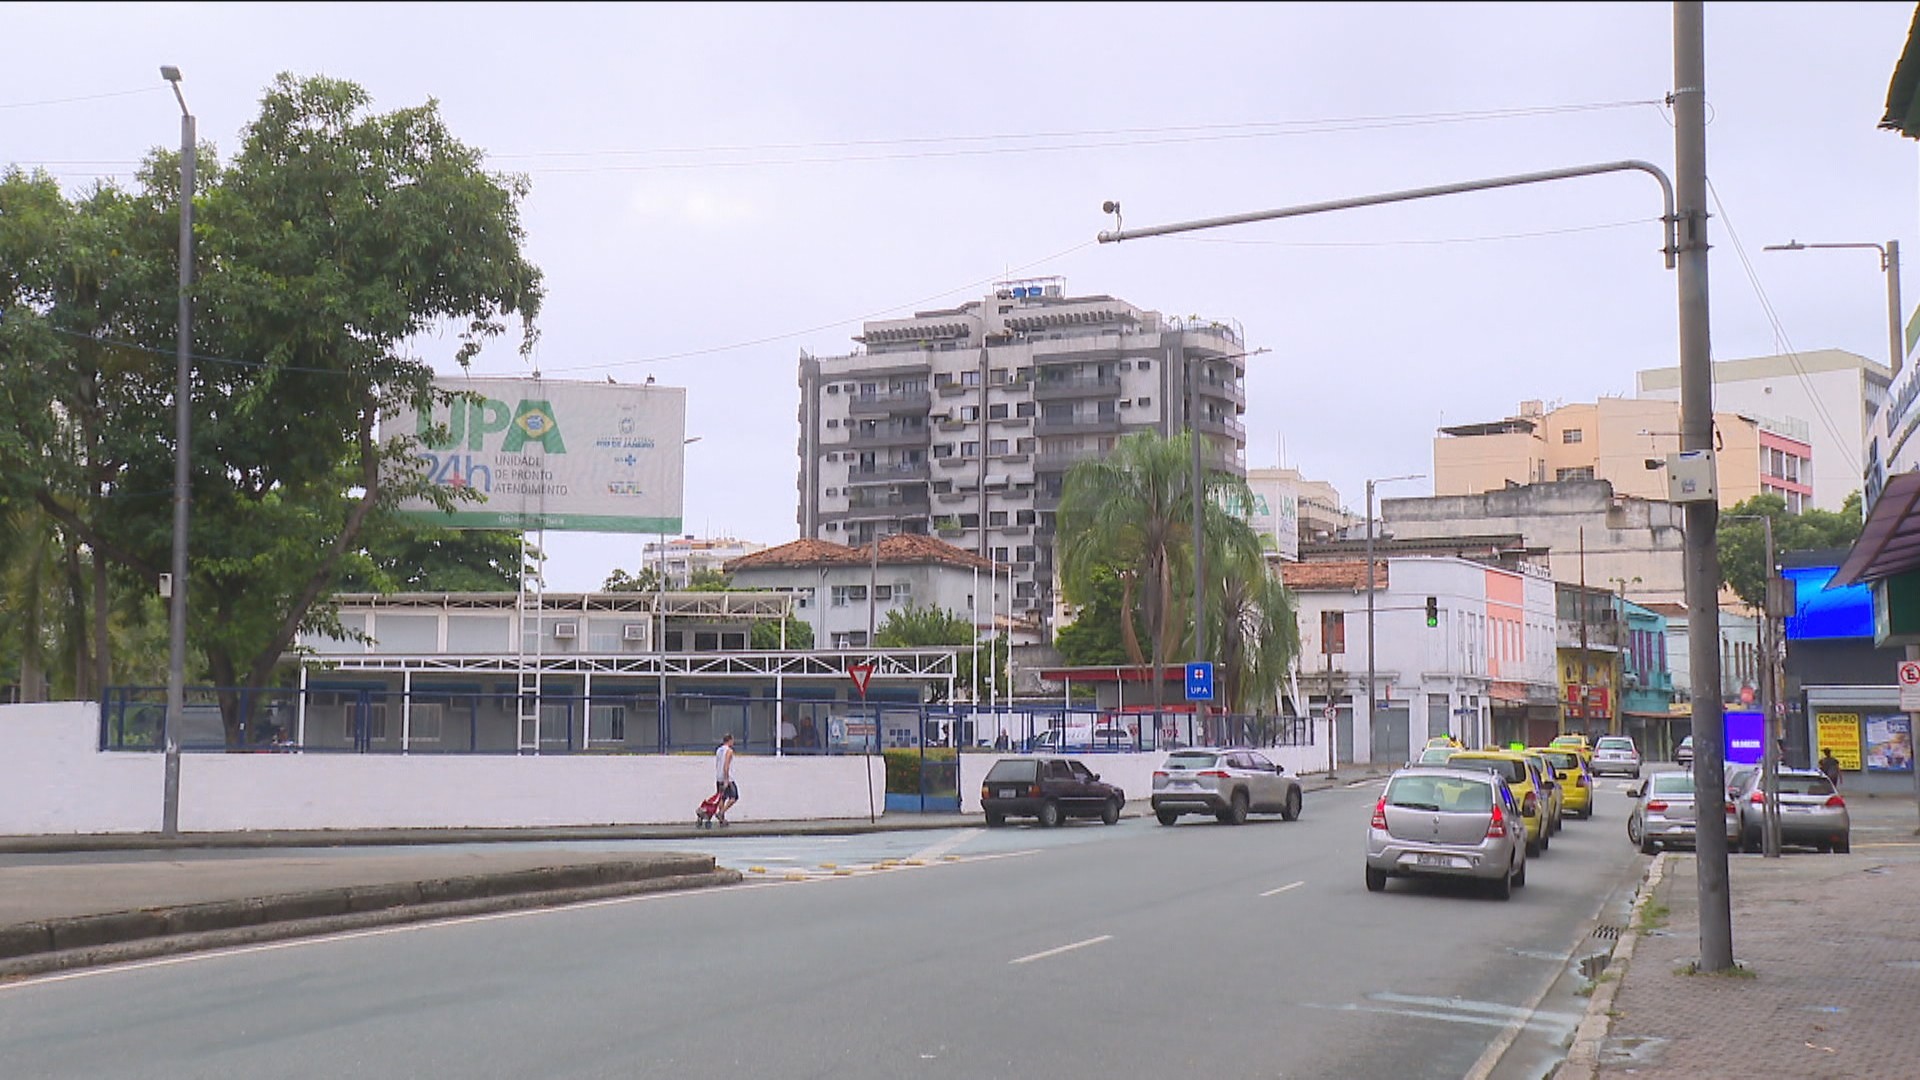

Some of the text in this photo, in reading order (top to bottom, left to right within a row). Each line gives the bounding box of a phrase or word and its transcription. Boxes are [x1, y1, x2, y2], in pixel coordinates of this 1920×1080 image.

[415, 397, 567, 454] UPA
[494, 454, 541, 467] UNIDADE
[416, 452, 491, 493] 24h
[494, 469, 553, 481] DE PRONTO
[494, 482, 568, 496] ATENDIMENTO
[1190, 686, 1208, 695] UPA
[1818, 714, 1857, 724] COMPRO
[1162, 729, 1179, 738] 192
